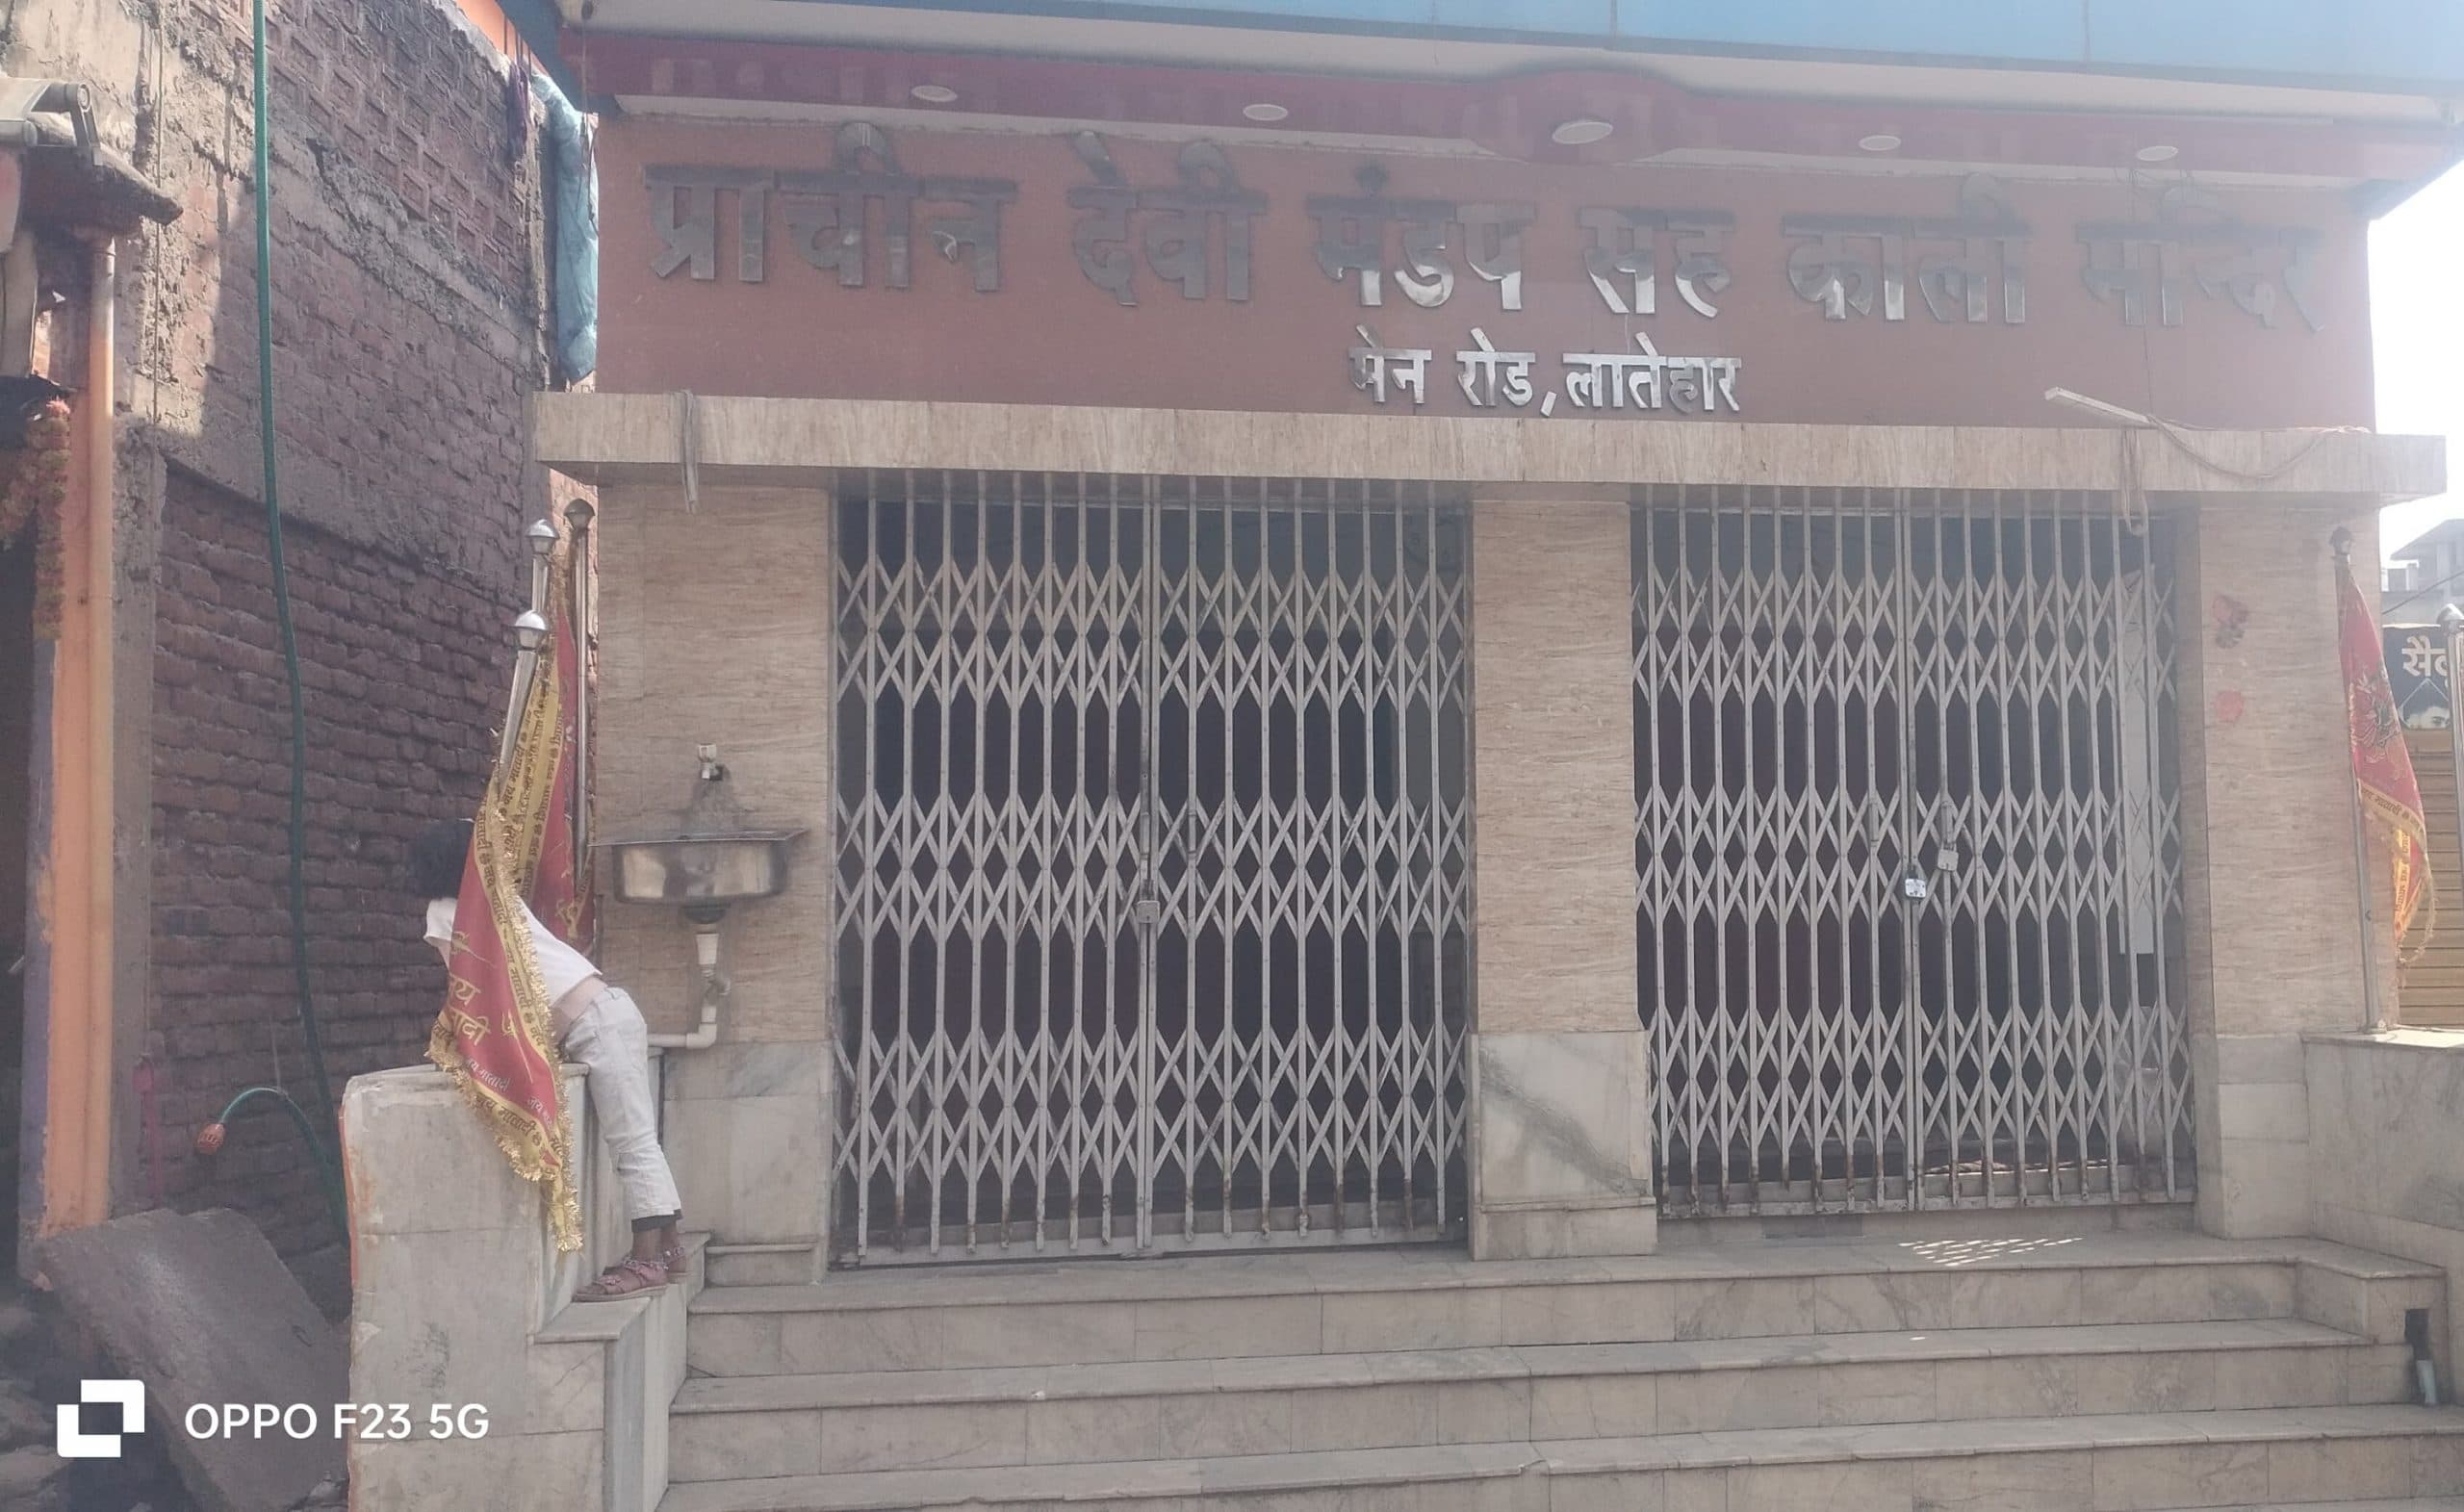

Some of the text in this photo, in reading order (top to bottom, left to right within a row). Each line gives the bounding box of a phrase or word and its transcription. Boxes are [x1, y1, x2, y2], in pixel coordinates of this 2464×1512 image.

[641, 120, 1019, 294] प्राचीन
[1066, 129, 1269, 307] देवी
[1305, 162, 1537, 312] मंडप
[1578, 205, 1736, 319] सह
[1781, 171, 2034, 324] काली
[1348, 324, 1433, 404] मेन
[1561, 331, 1743, 414] लातेहार
